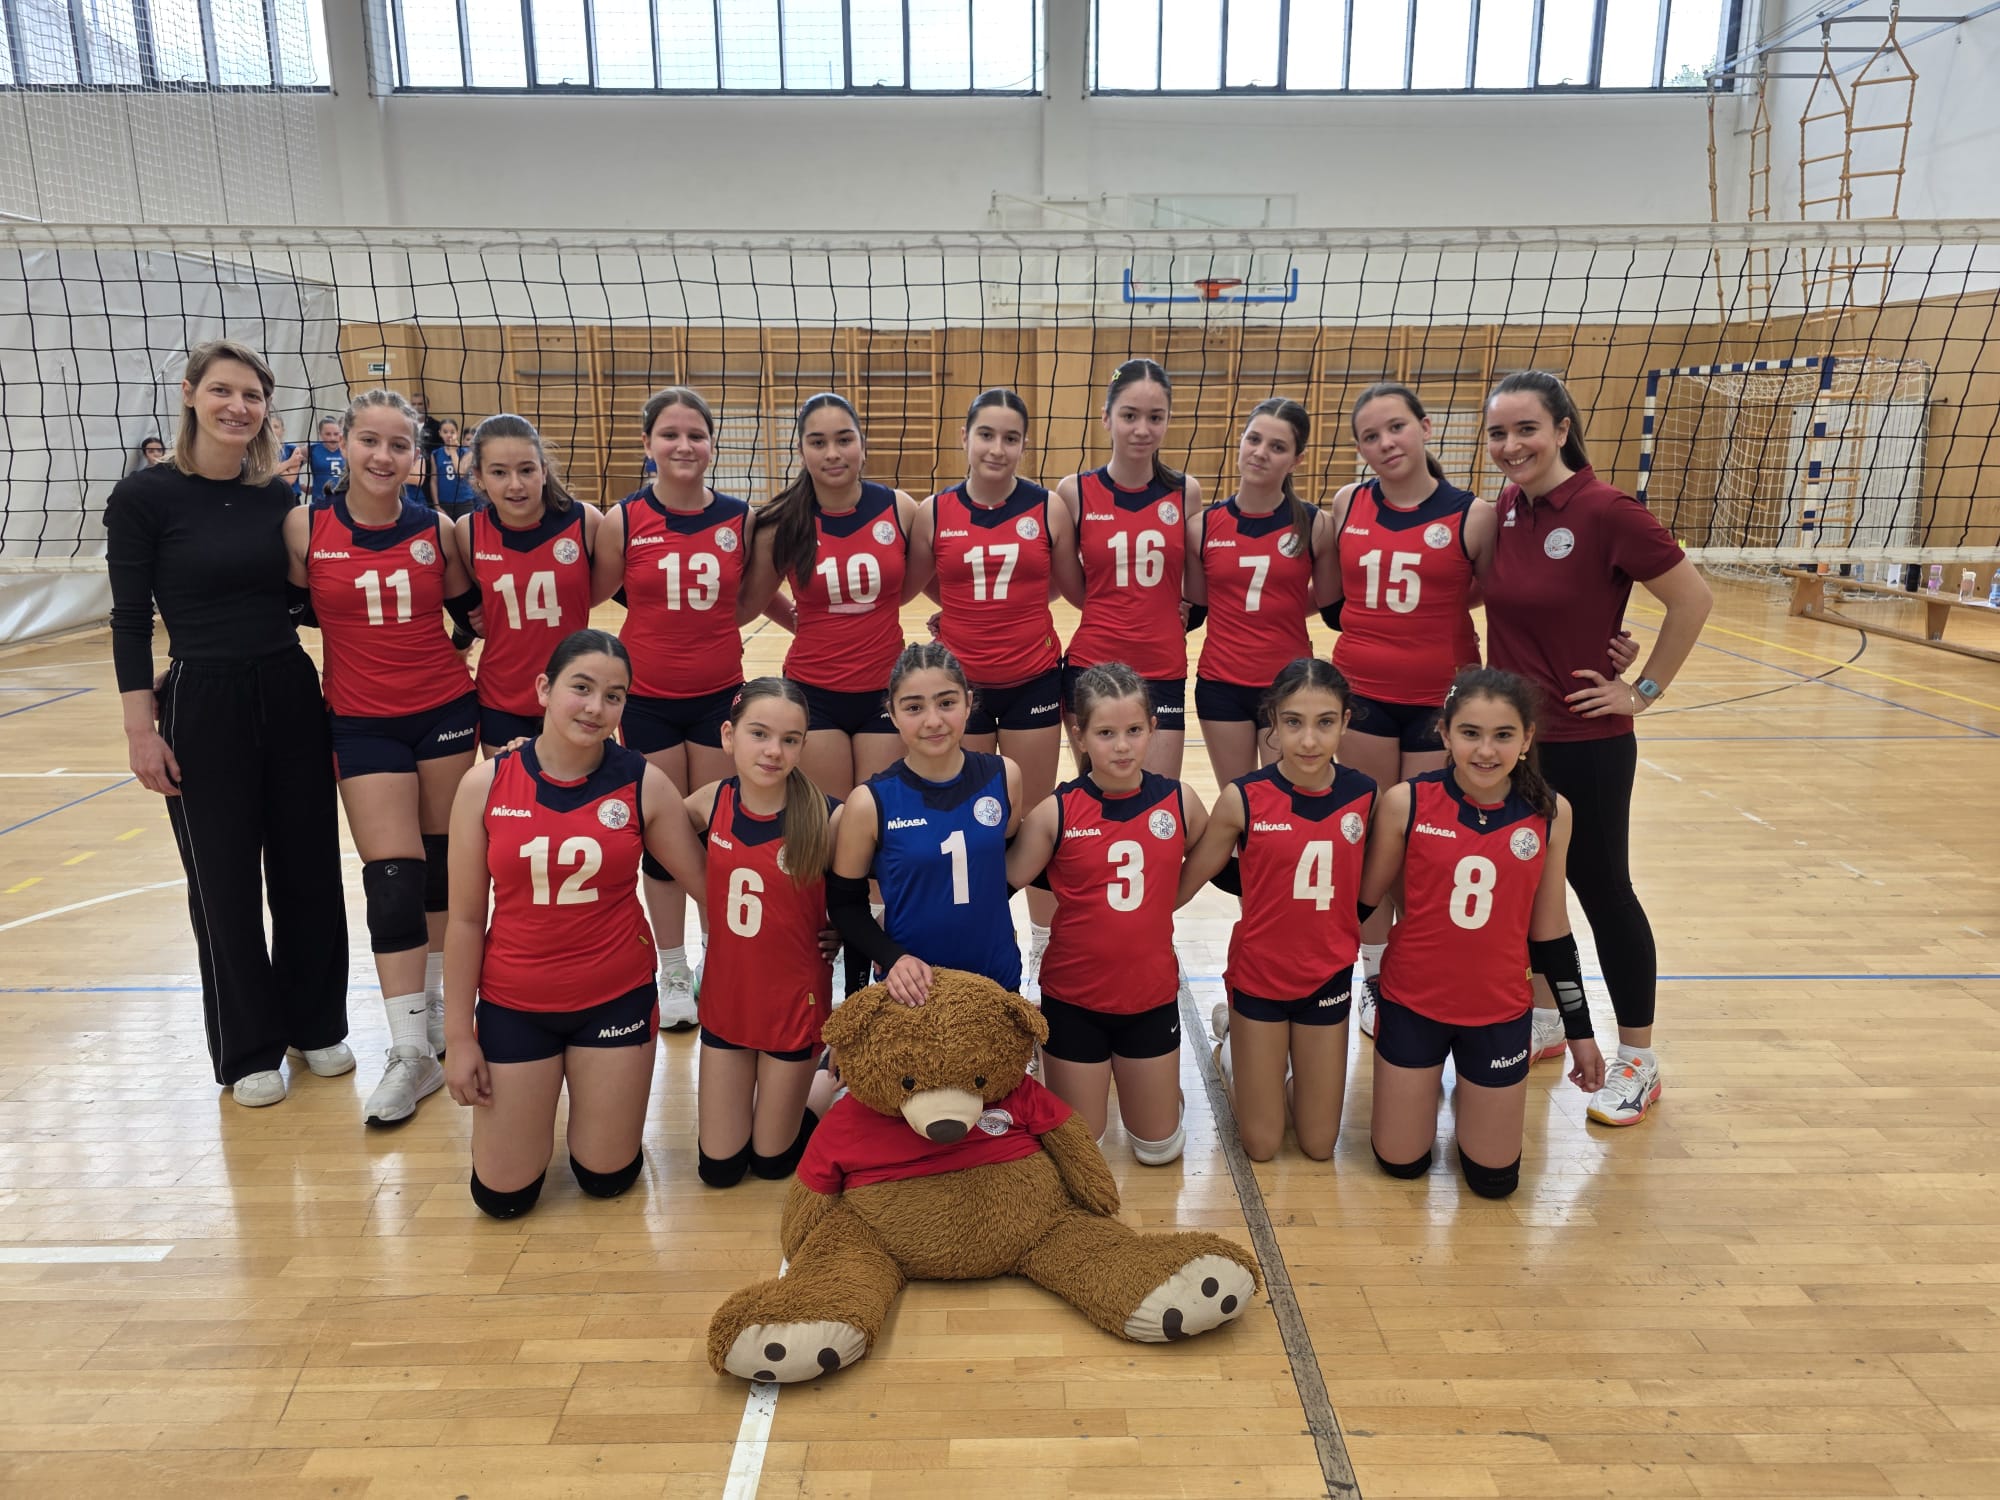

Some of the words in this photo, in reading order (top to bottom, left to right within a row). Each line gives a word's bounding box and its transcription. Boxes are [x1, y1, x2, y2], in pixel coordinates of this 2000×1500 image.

[658, 552, 720, 611] 13
[816, 553, 880, 603] 10
[964, 543, 1019, 600] 17
[1108, 530, 1165, 586] 16
[1239, 555, 1270, 611] 7
[1359, 550, 1421, 613] 15
[355, 569, 411, 625] 11
[493, 571, 561, 629] 14
[520, 836, 602, 904] 12
[941, 830, 969, 904] 1
[1107, 840, 1144, 911] 3
[1293, 841, 1334, 910] 4
[1450, 856, 1496, 929] 8
[727, 868, 764, 937] 6
